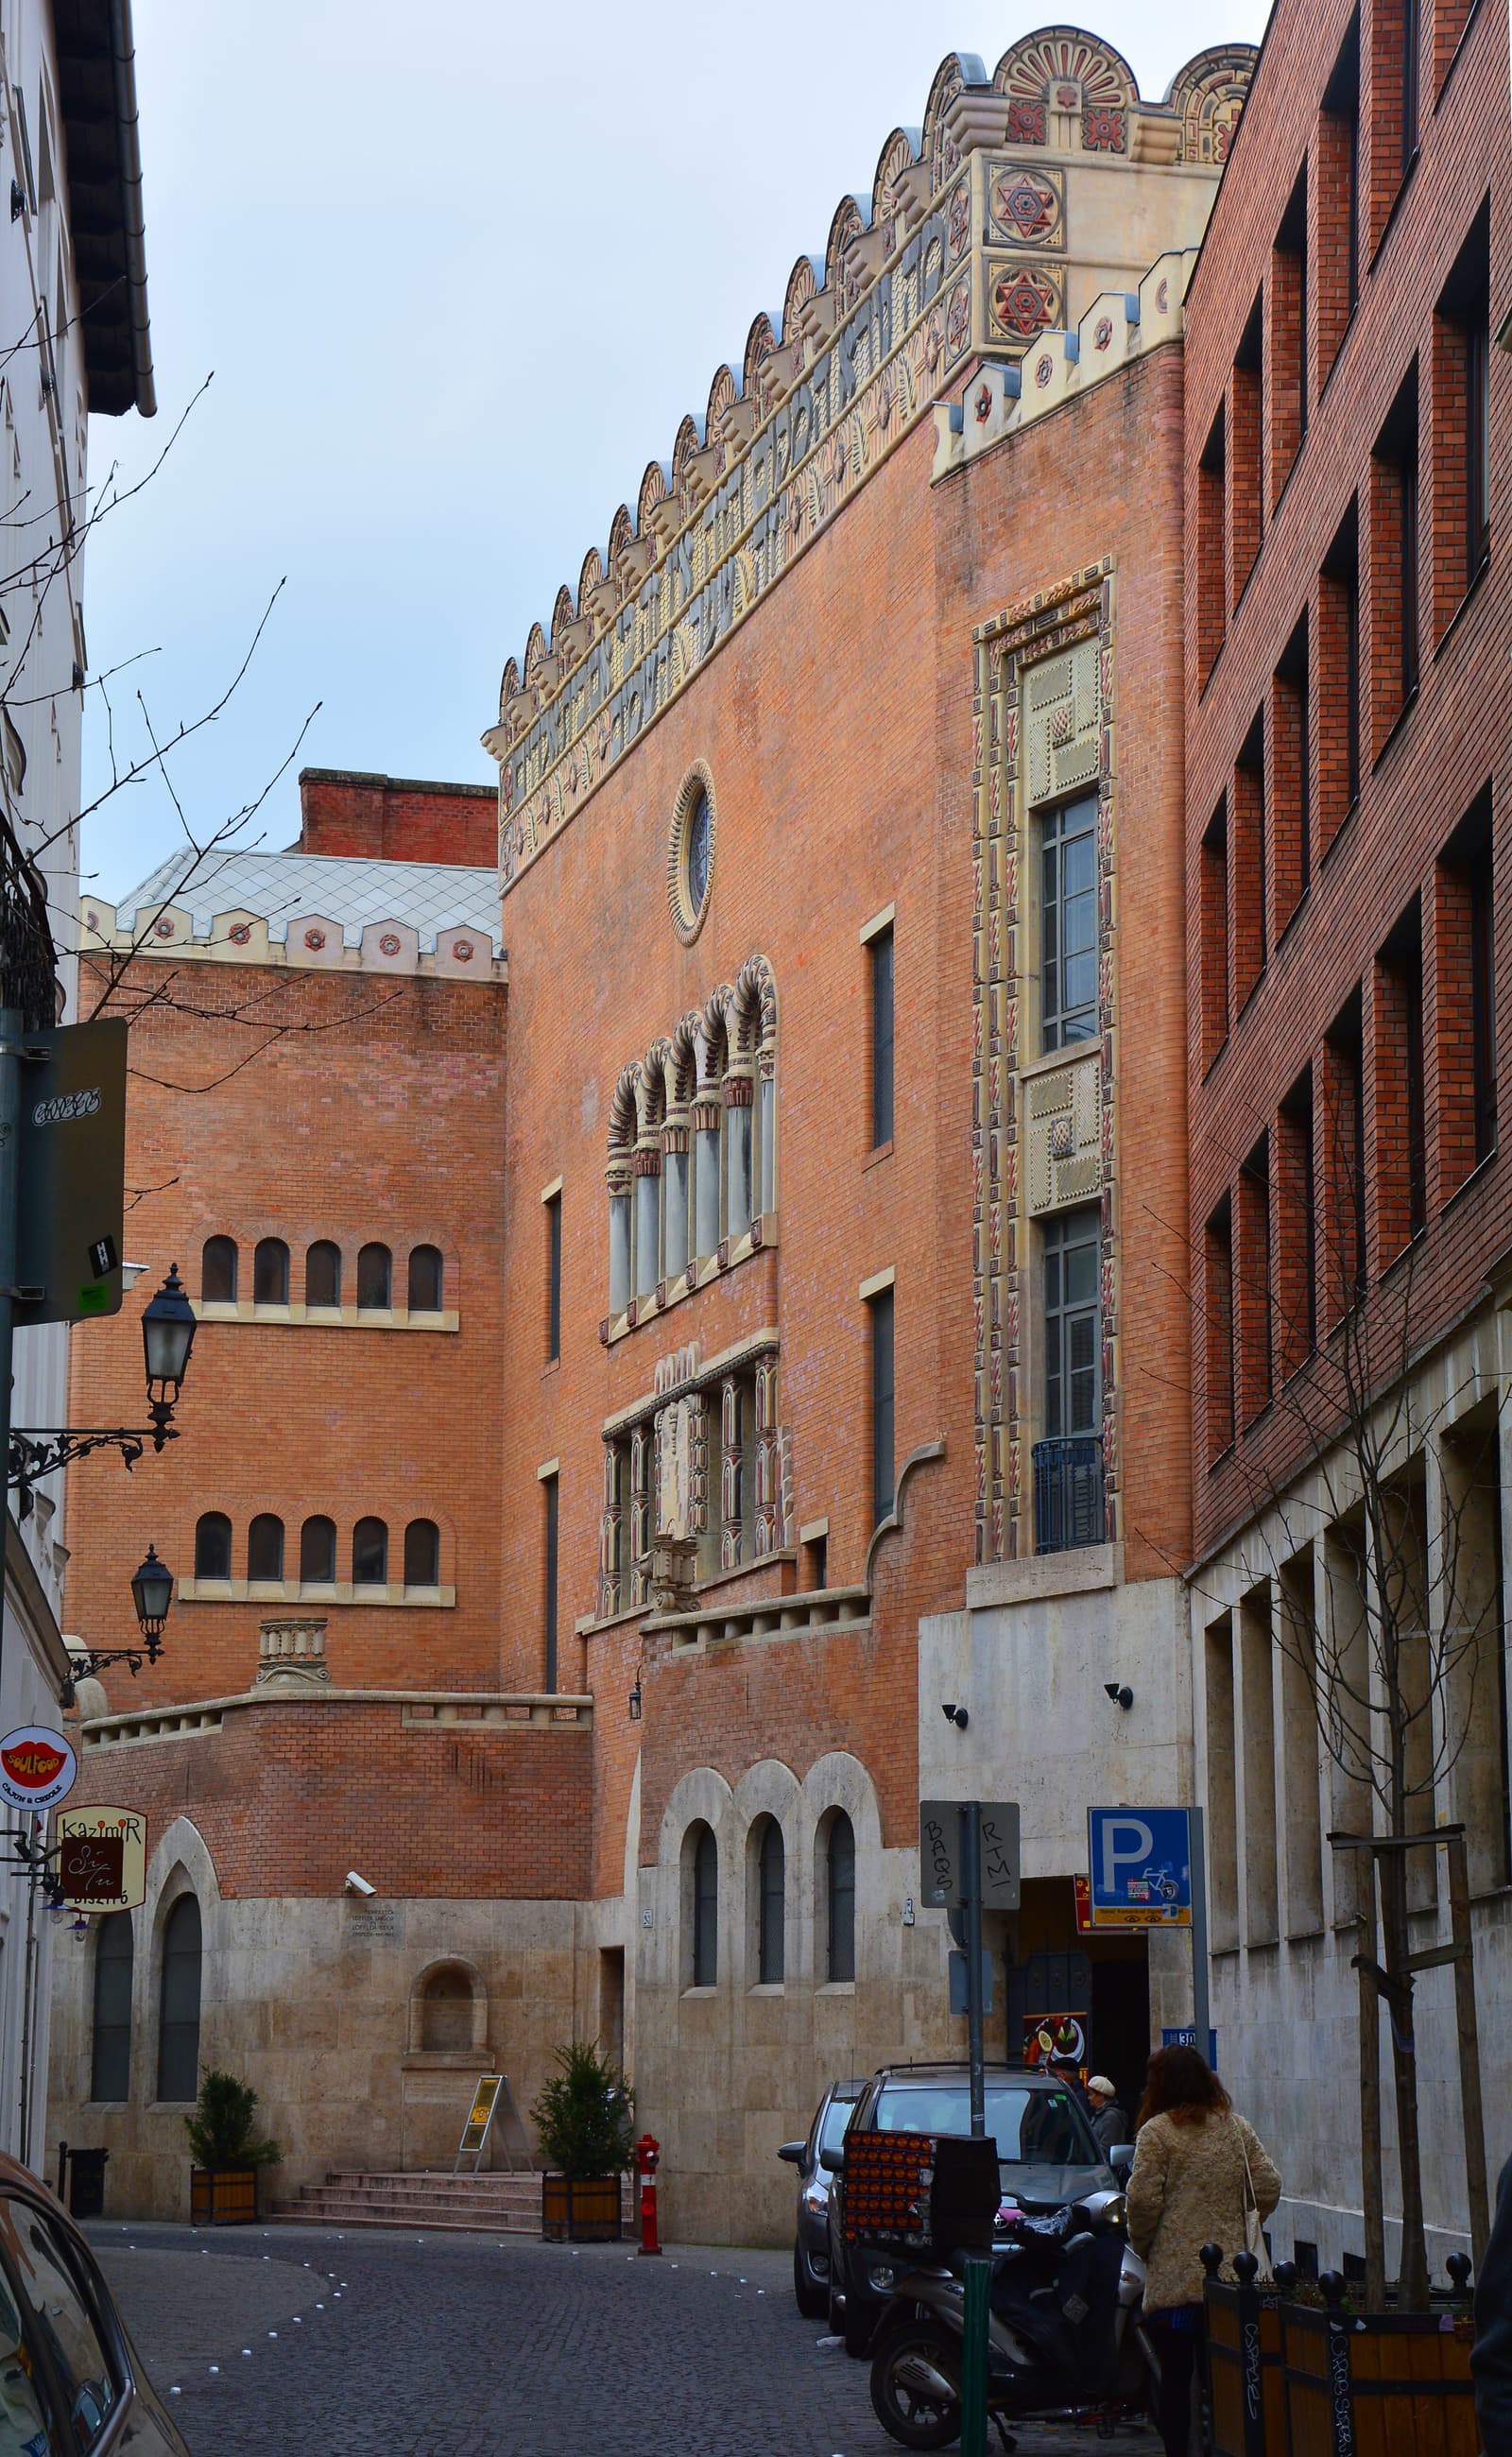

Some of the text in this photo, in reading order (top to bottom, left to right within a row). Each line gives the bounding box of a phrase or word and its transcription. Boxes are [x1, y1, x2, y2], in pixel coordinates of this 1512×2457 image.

[2, 1782, 25, 1803] CAJUN
[34, 1784, 62, 1804] CREOLE
[1102, 1818, 1154, 1892] P
